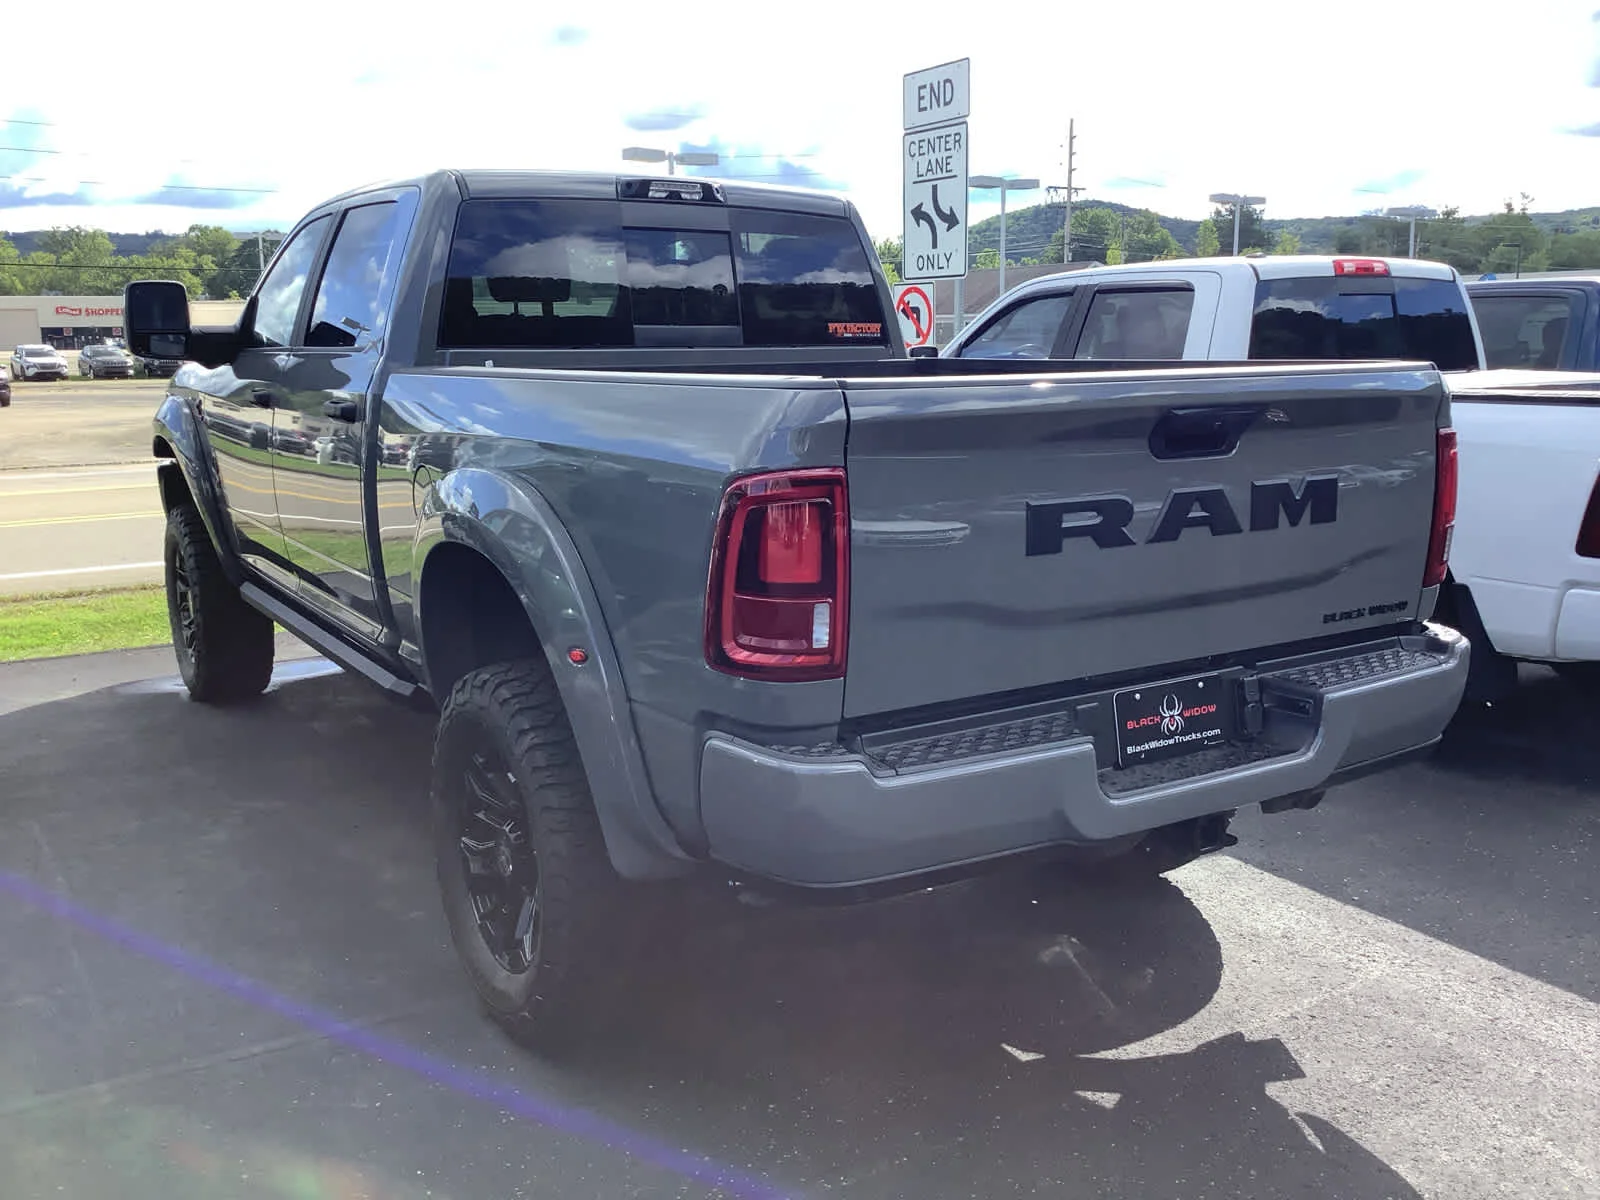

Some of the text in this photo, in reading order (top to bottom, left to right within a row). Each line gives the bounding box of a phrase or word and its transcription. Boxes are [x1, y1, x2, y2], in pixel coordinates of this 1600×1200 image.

[917, 78, 954, 112] END
[908, 132, 962, 158] CENTER
[916, 155, 953, 178] LANE
[916, 252, 952, 271] ONLY
[1025, 473, 1339, 556] RAM
[1322, 600, 1408, 624] BLACK WIDOW
[1126, 704, 1217, 730] BLACK WIDOW
[1126, 728, 1221, 754] BlackWidowTrucks.com
